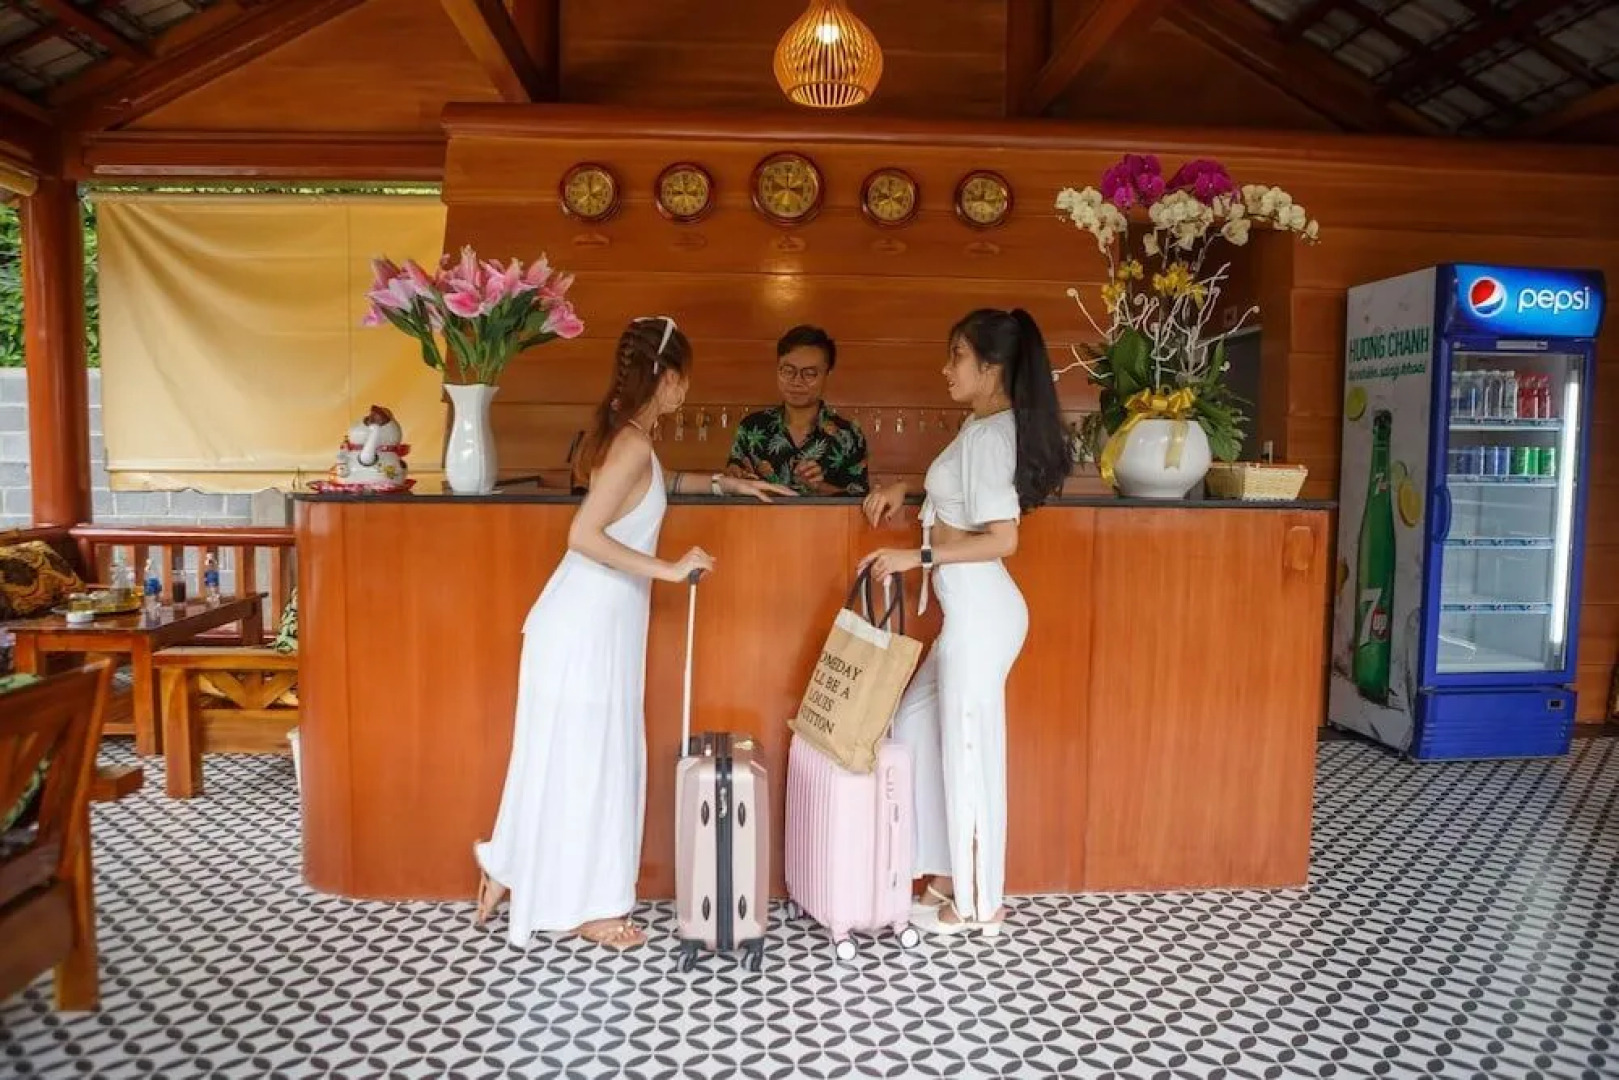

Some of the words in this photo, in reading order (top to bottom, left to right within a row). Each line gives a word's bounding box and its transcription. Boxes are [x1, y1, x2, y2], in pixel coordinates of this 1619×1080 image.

[1517, 286, 1590, 315] pepsi
[825, 676, 841, 694] BE
[839, 686, 850, 700] A
